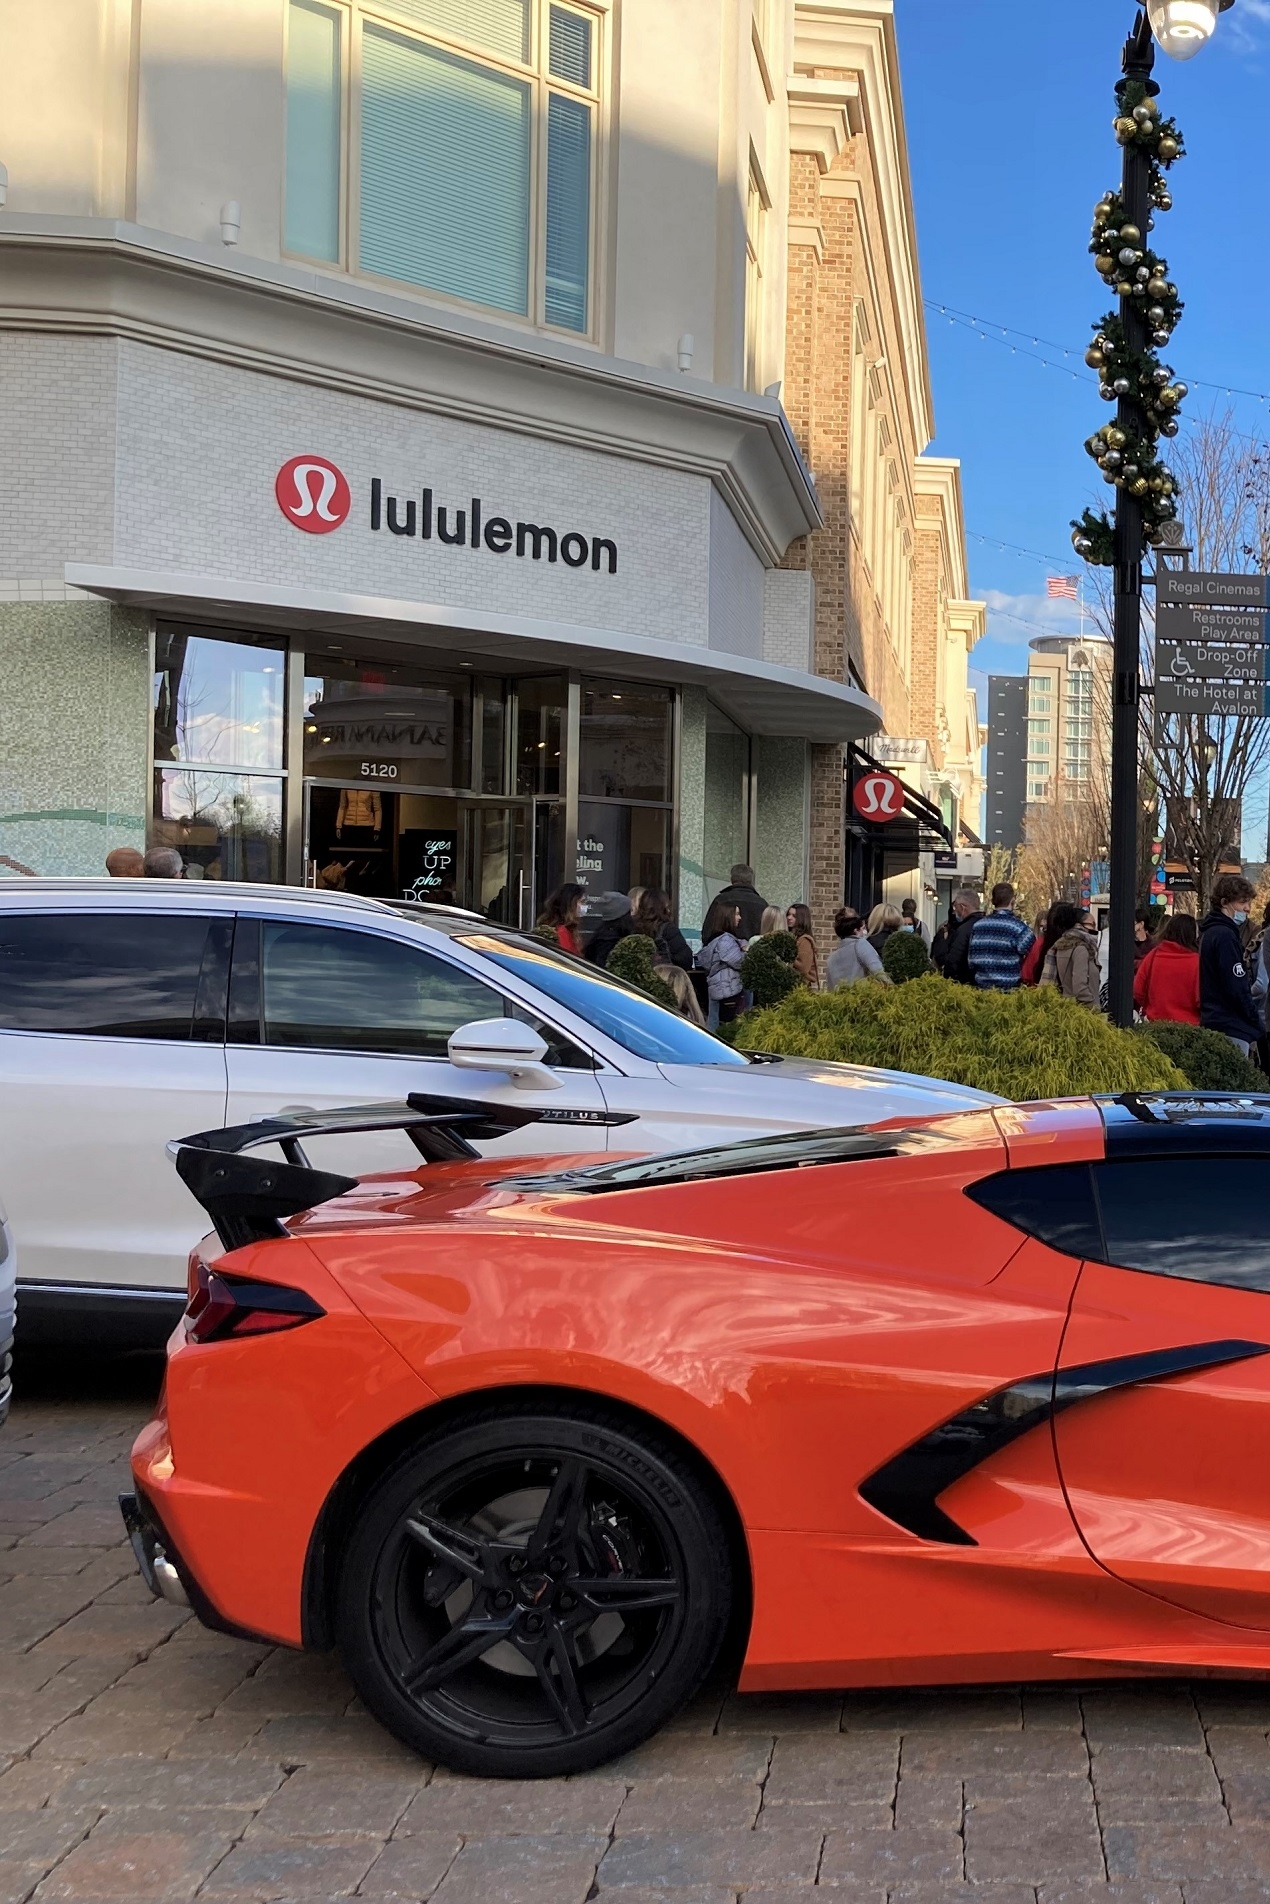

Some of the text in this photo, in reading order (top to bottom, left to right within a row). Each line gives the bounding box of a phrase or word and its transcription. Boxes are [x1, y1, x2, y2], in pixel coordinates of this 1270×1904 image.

[371, 477, 618, 575] lululemon
[1168, 580, 1260, 596] Regal Cinemas
[1193, 611, 1260, 626] Restrooms
[1201, 626, 1259, 642] Play Area
[1197, 648, 1258, 664] Drop-Off
[1224, 664, 1258, 678] Zone
[1174, 684, 1258, 700] The Hotel at
[1211, 702, 1257, 715] Avalon
[361, 763, 398, 778] 5120
[425, 840, 452, 855] eyes
[584, 838, 604, 851] the
[422, 856, 451, 869] UP
[412, 870, 442, 889] pho
